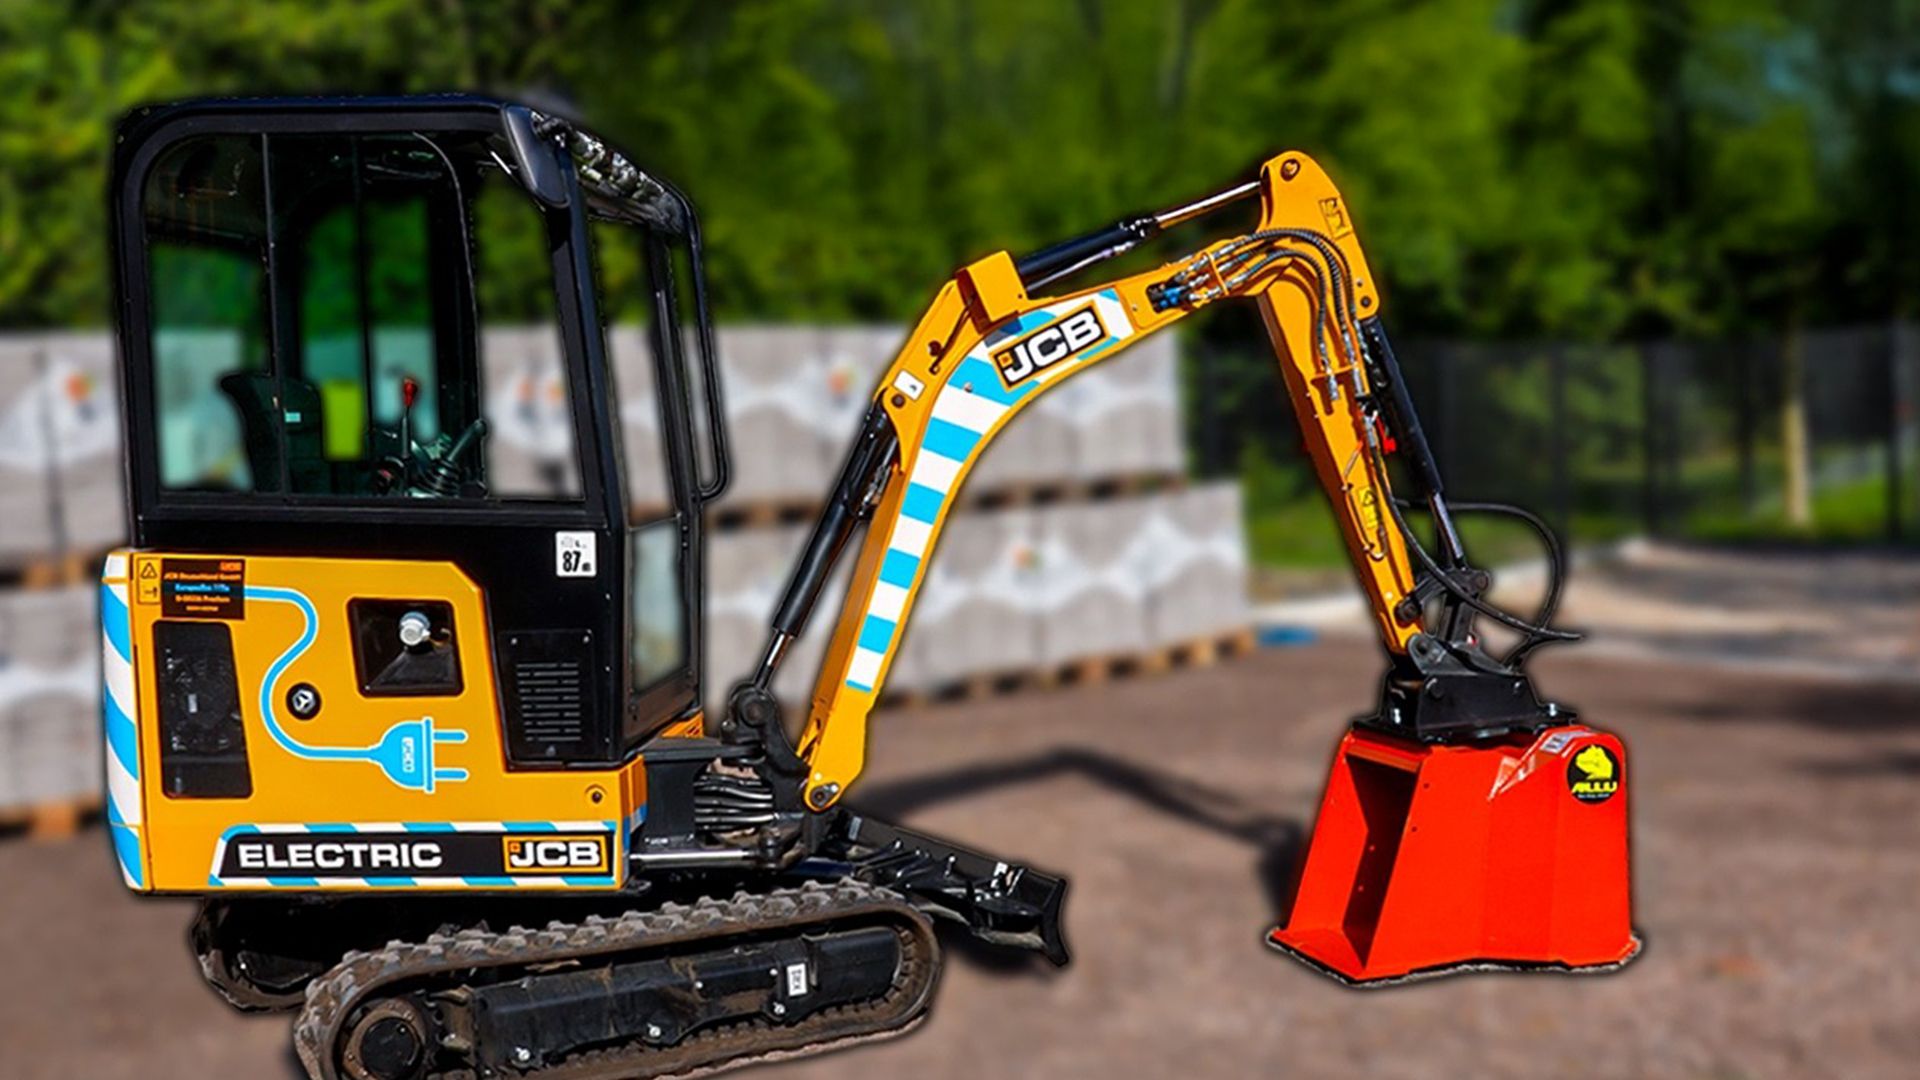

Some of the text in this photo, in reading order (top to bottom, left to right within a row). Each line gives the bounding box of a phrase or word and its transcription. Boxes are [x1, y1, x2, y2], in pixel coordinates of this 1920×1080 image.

[1002, 311, 1102, 382] JCB
[563, 550, 581, 572] 87
[237, 841, 601, 869] ELECTRIC JCB
